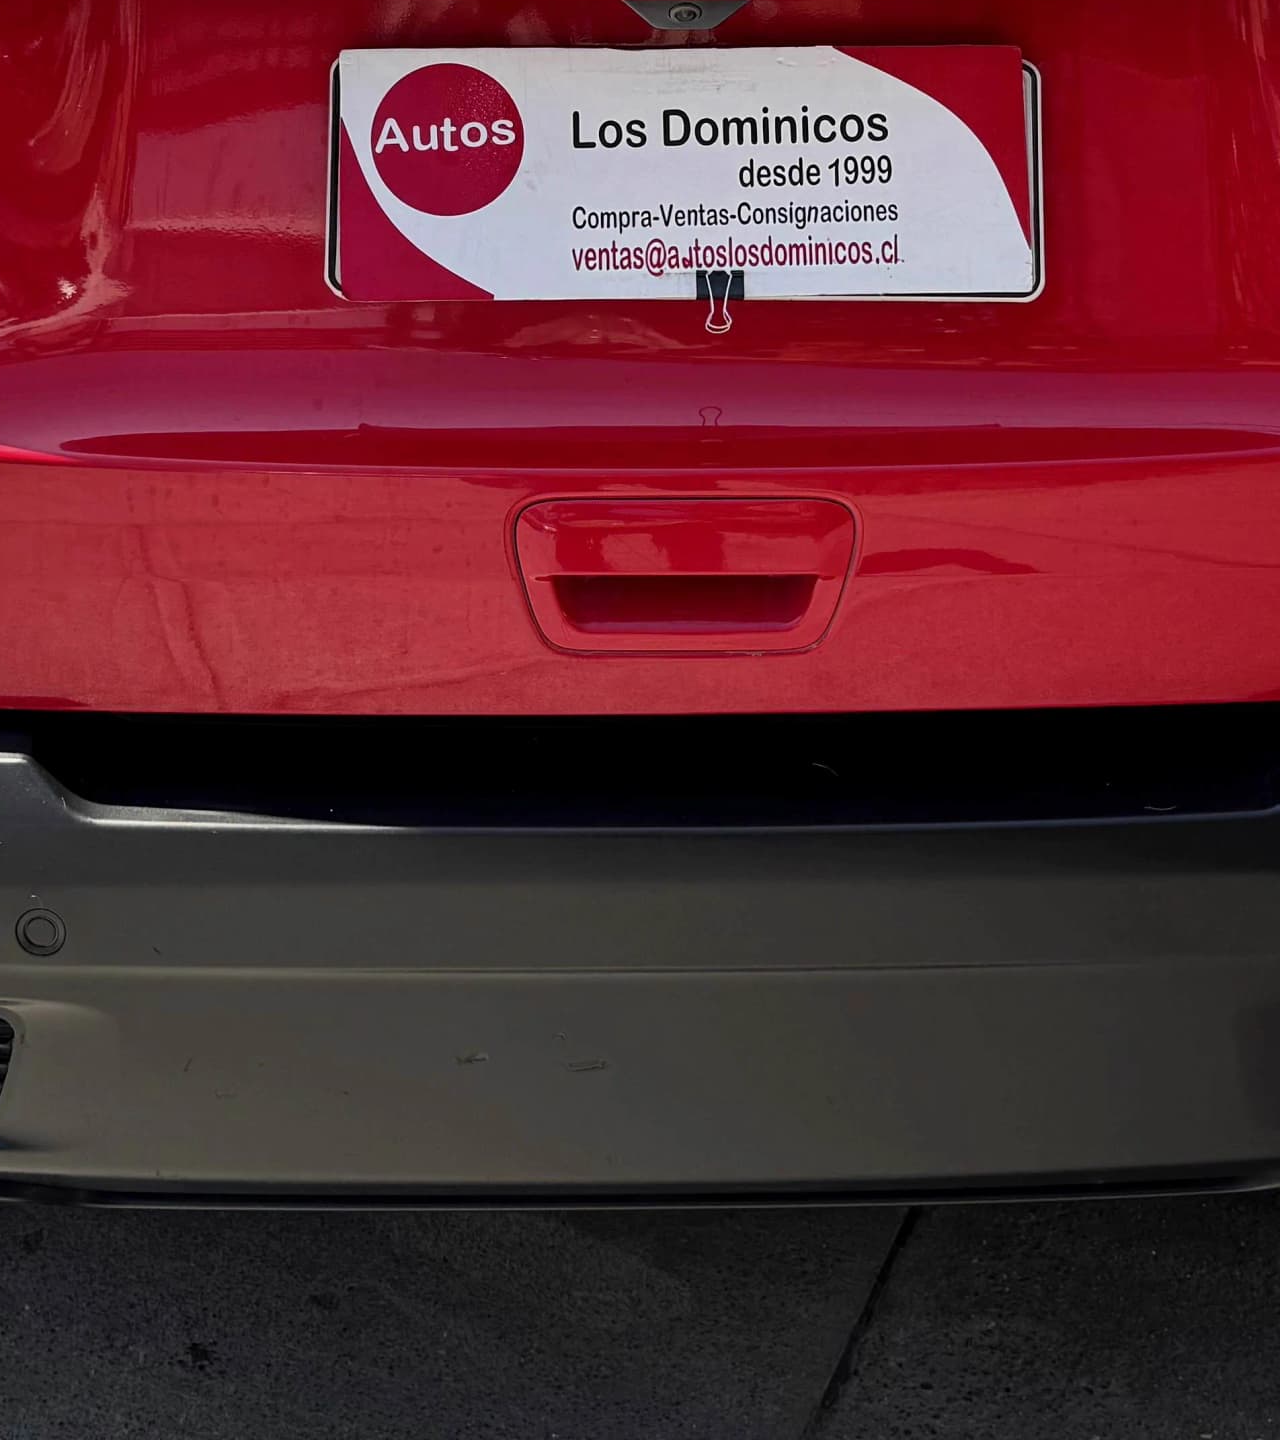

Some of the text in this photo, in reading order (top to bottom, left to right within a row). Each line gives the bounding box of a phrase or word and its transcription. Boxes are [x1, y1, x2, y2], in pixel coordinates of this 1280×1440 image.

[375, 117, 516, 153] Autos
[572, 106, 889, 149] Los Dominicos
[738, 155, 893, 187] desde 1999
[572, 201, 899, 233] Compra-Ventas-Consignaciones
